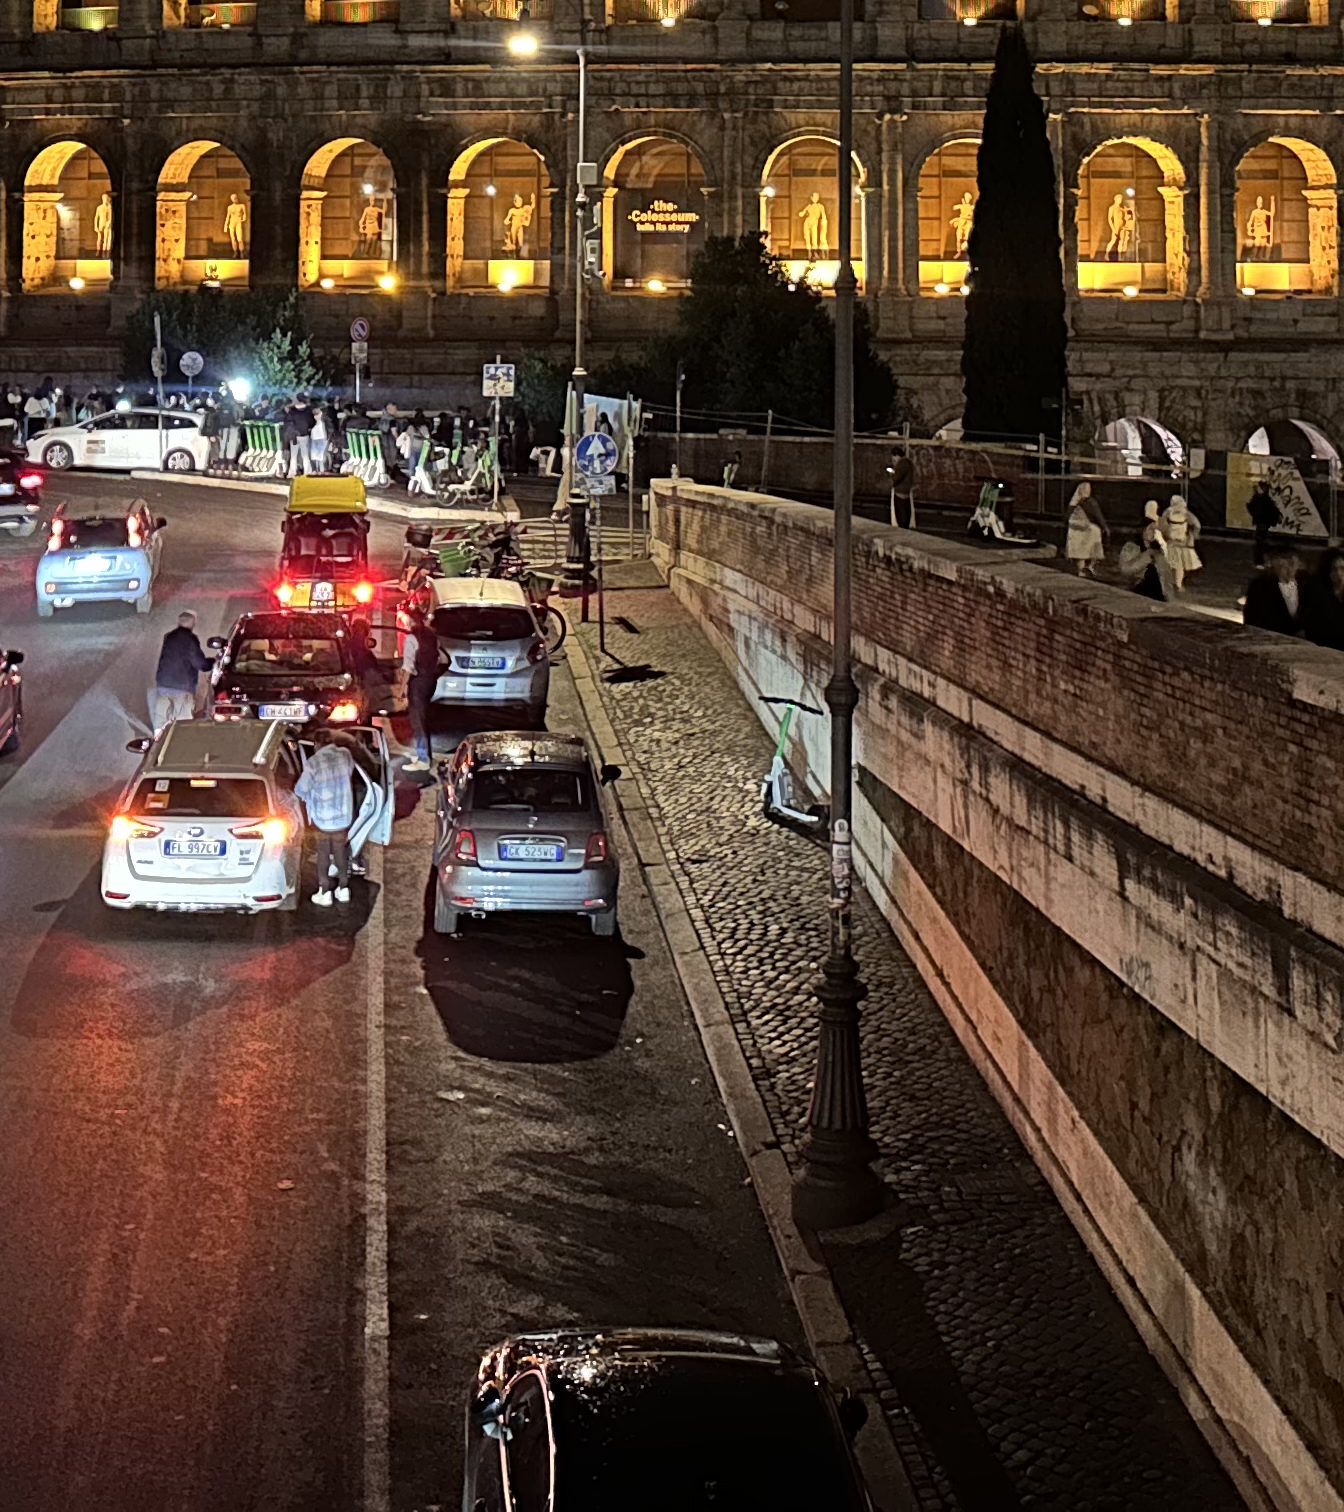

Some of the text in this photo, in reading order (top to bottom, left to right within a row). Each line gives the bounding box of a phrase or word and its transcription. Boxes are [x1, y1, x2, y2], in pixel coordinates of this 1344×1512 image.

[654, 200, 674, 211] the
[632, 210, 696, 222] Colosseum
[668, 223, 690, 233] story
[171, 843, 183, 853] FL
